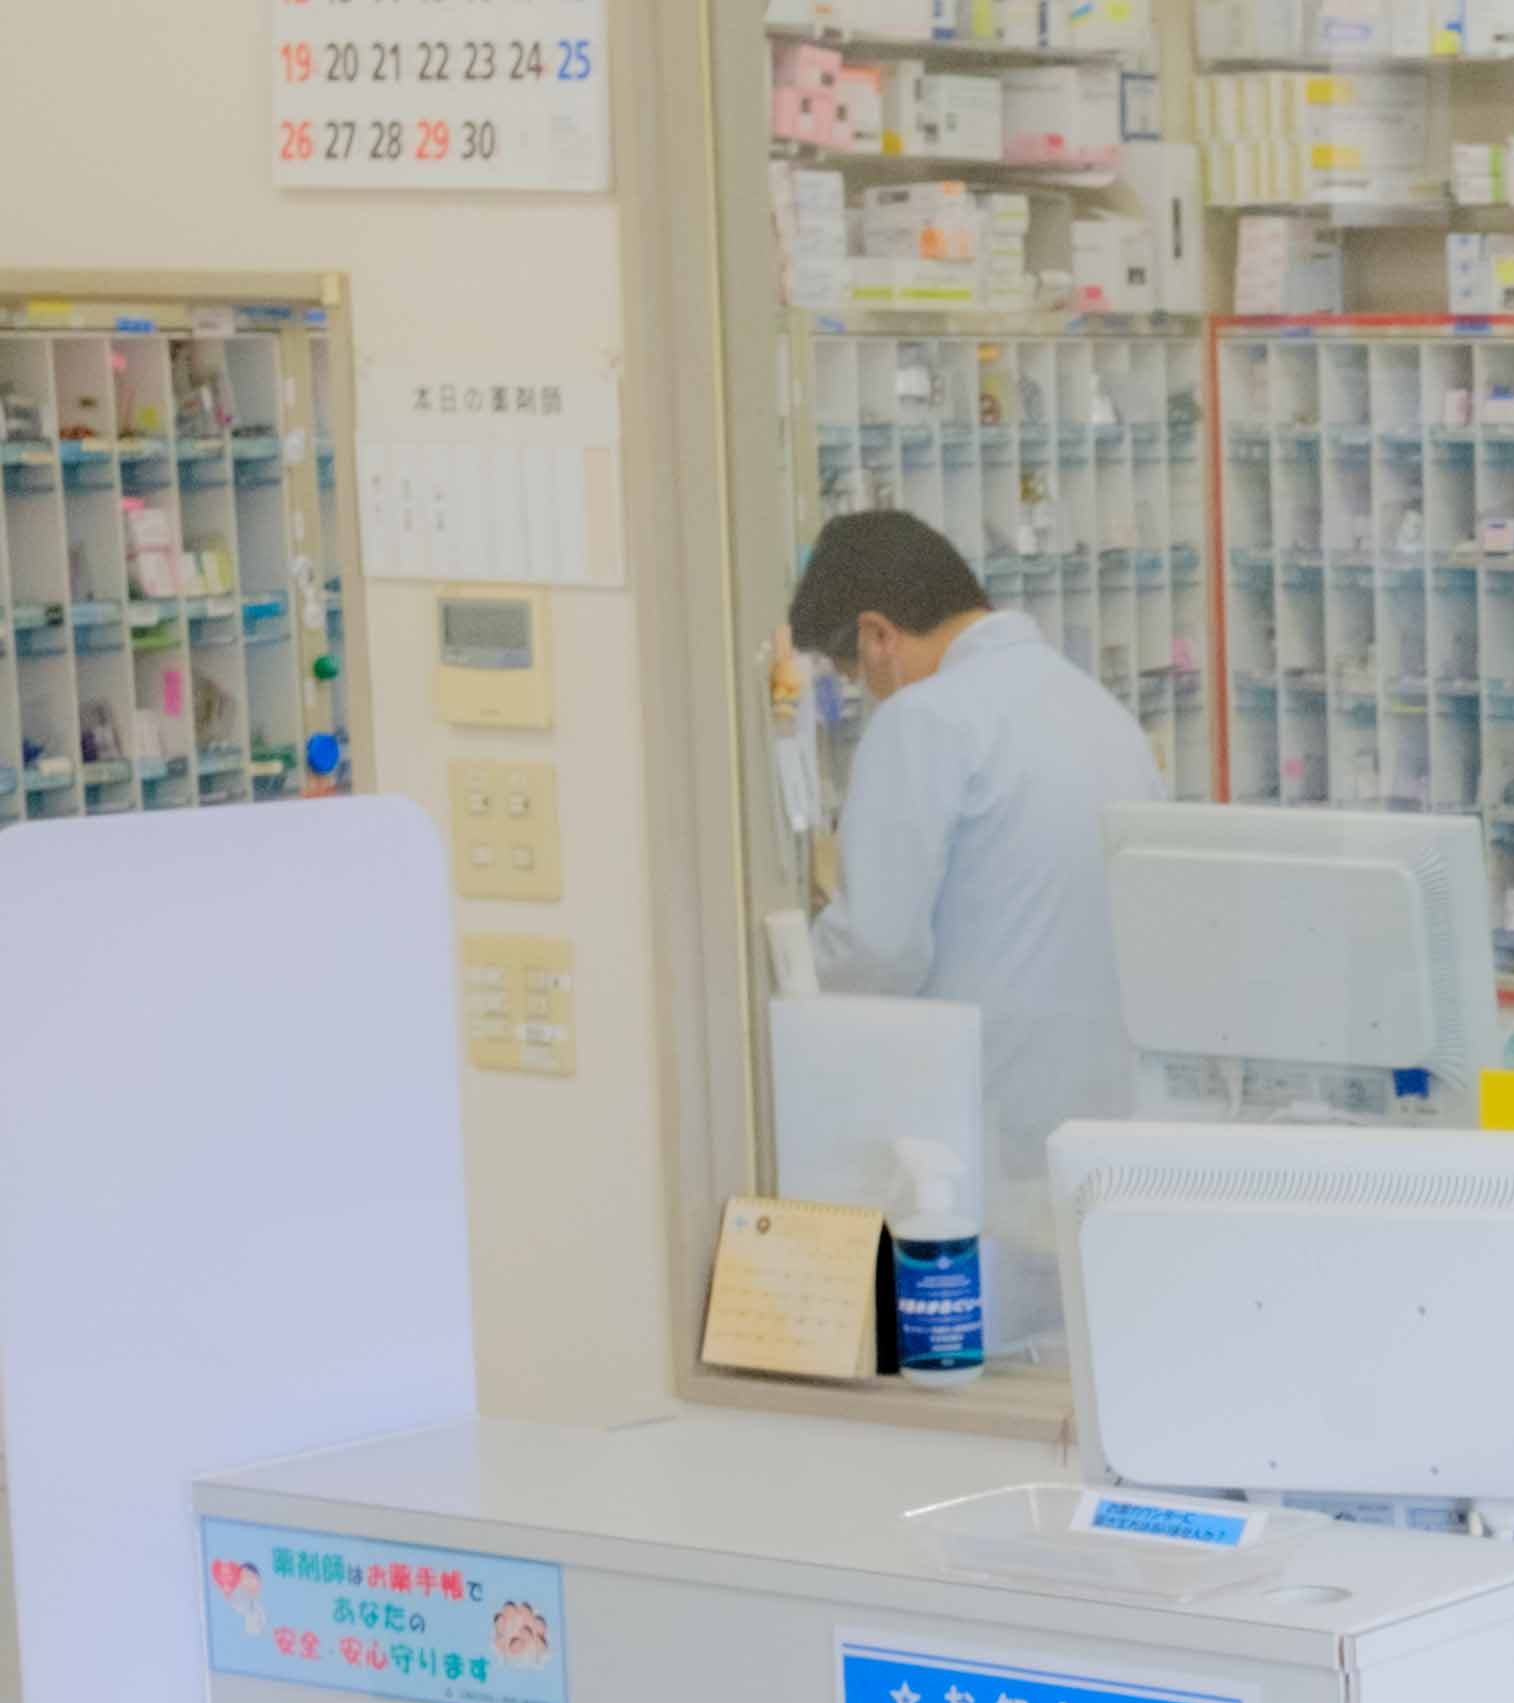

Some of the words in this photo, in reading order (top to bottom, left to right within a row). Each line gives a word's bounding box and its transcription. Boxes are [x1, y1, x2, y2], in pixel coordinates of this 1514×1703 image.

[280, 43, 312, 82] 19
[325, 43, 359, 82] 20
[371, 43, 401, 82] 21
[417, 42, 449, 82] 22
[463, 42, 496, 81] 23
[509, 41, 544, 81] 24
[556, 40, 591, 80] 25
[280, 122, 313, 160] 26
[324, 122, 357, 159] 27
[369, 121, 402, 160] 28
[415, 121, 449, 160] 29
[460, 121, 495, 160] 30
[271, 1546, 486, 1603] 薬剤師はお薬手帳で
[332, 1597, 427, 1635] あなたの
